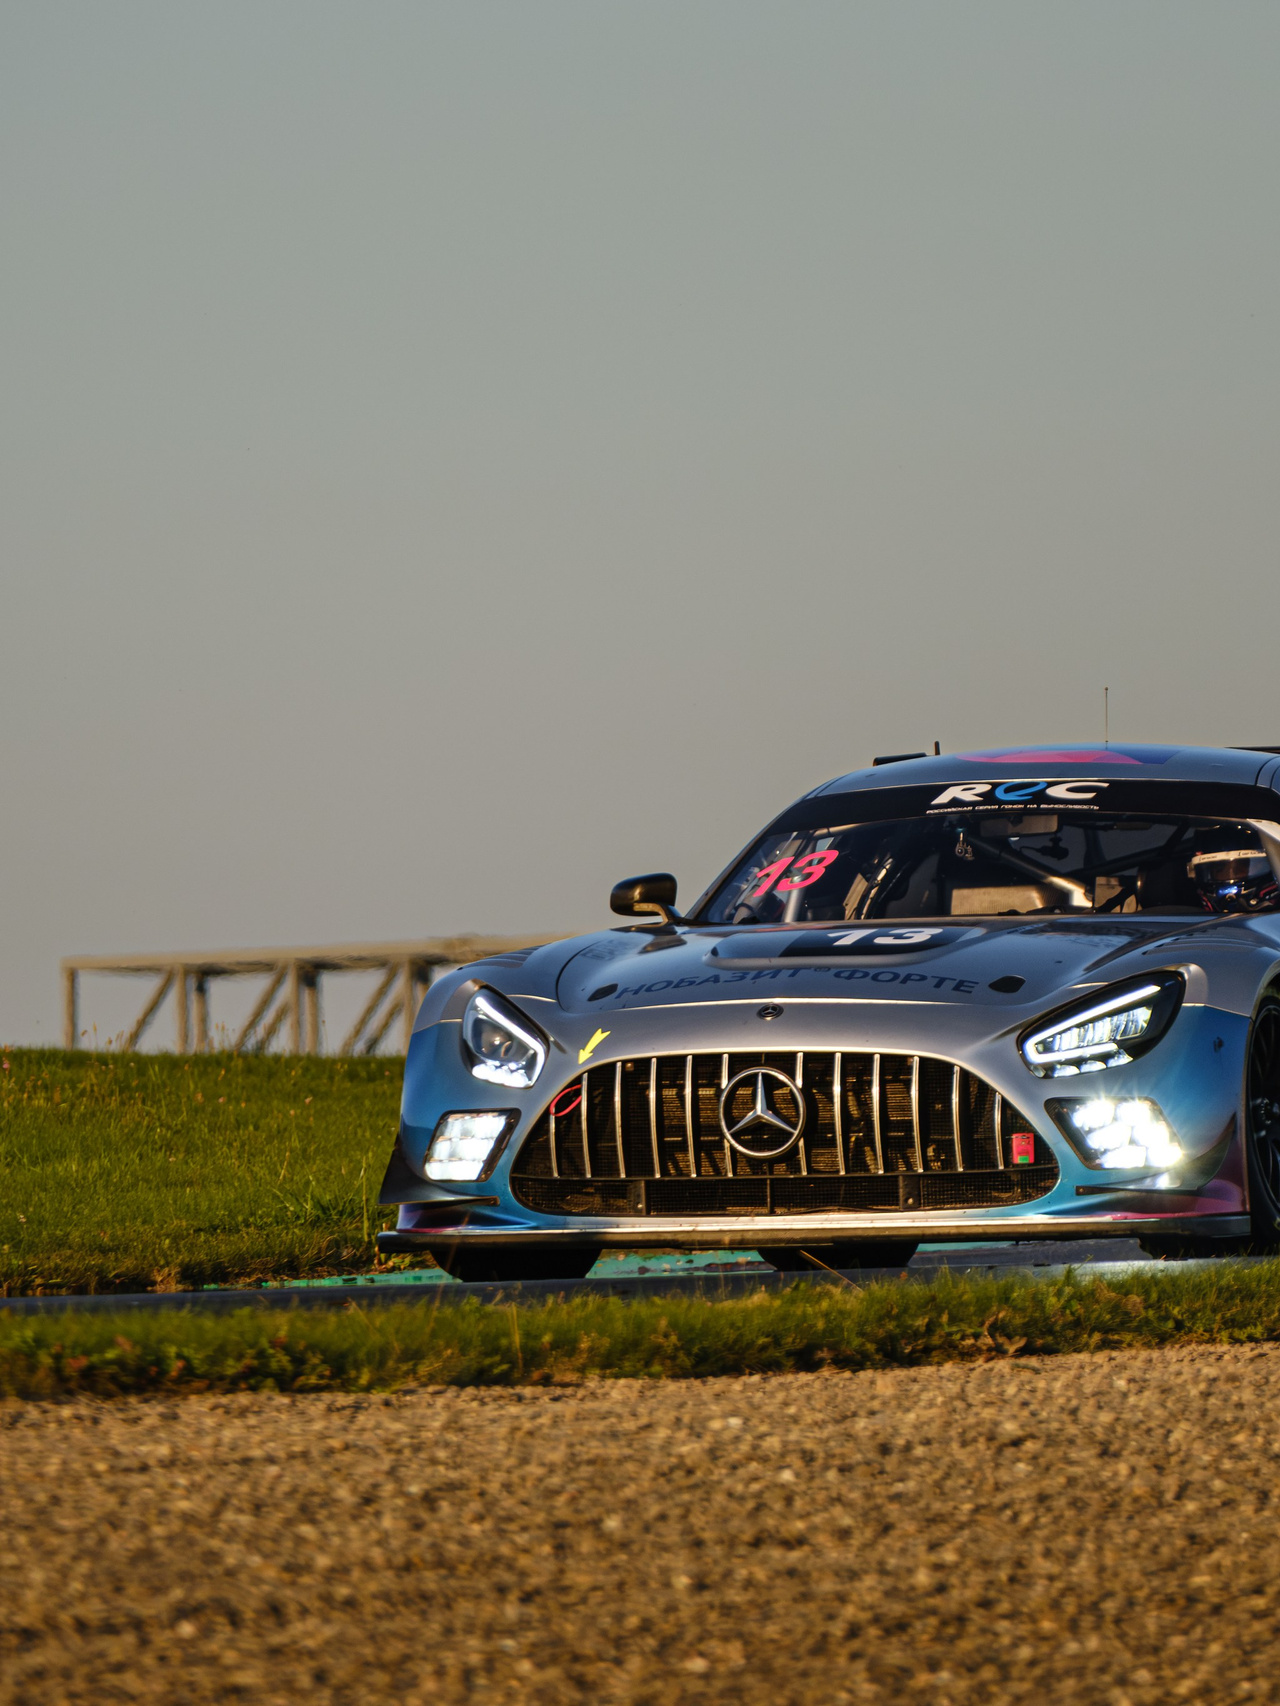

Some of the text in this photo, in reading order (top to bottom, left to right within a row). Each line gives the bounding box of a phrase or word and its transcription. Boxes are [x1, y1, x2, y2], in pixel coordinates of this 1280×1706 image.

[752, 849, 840, 898] 13
[827, 927, 944, 946] 13
[833, 967, 981, 995] ФОРТЕ
